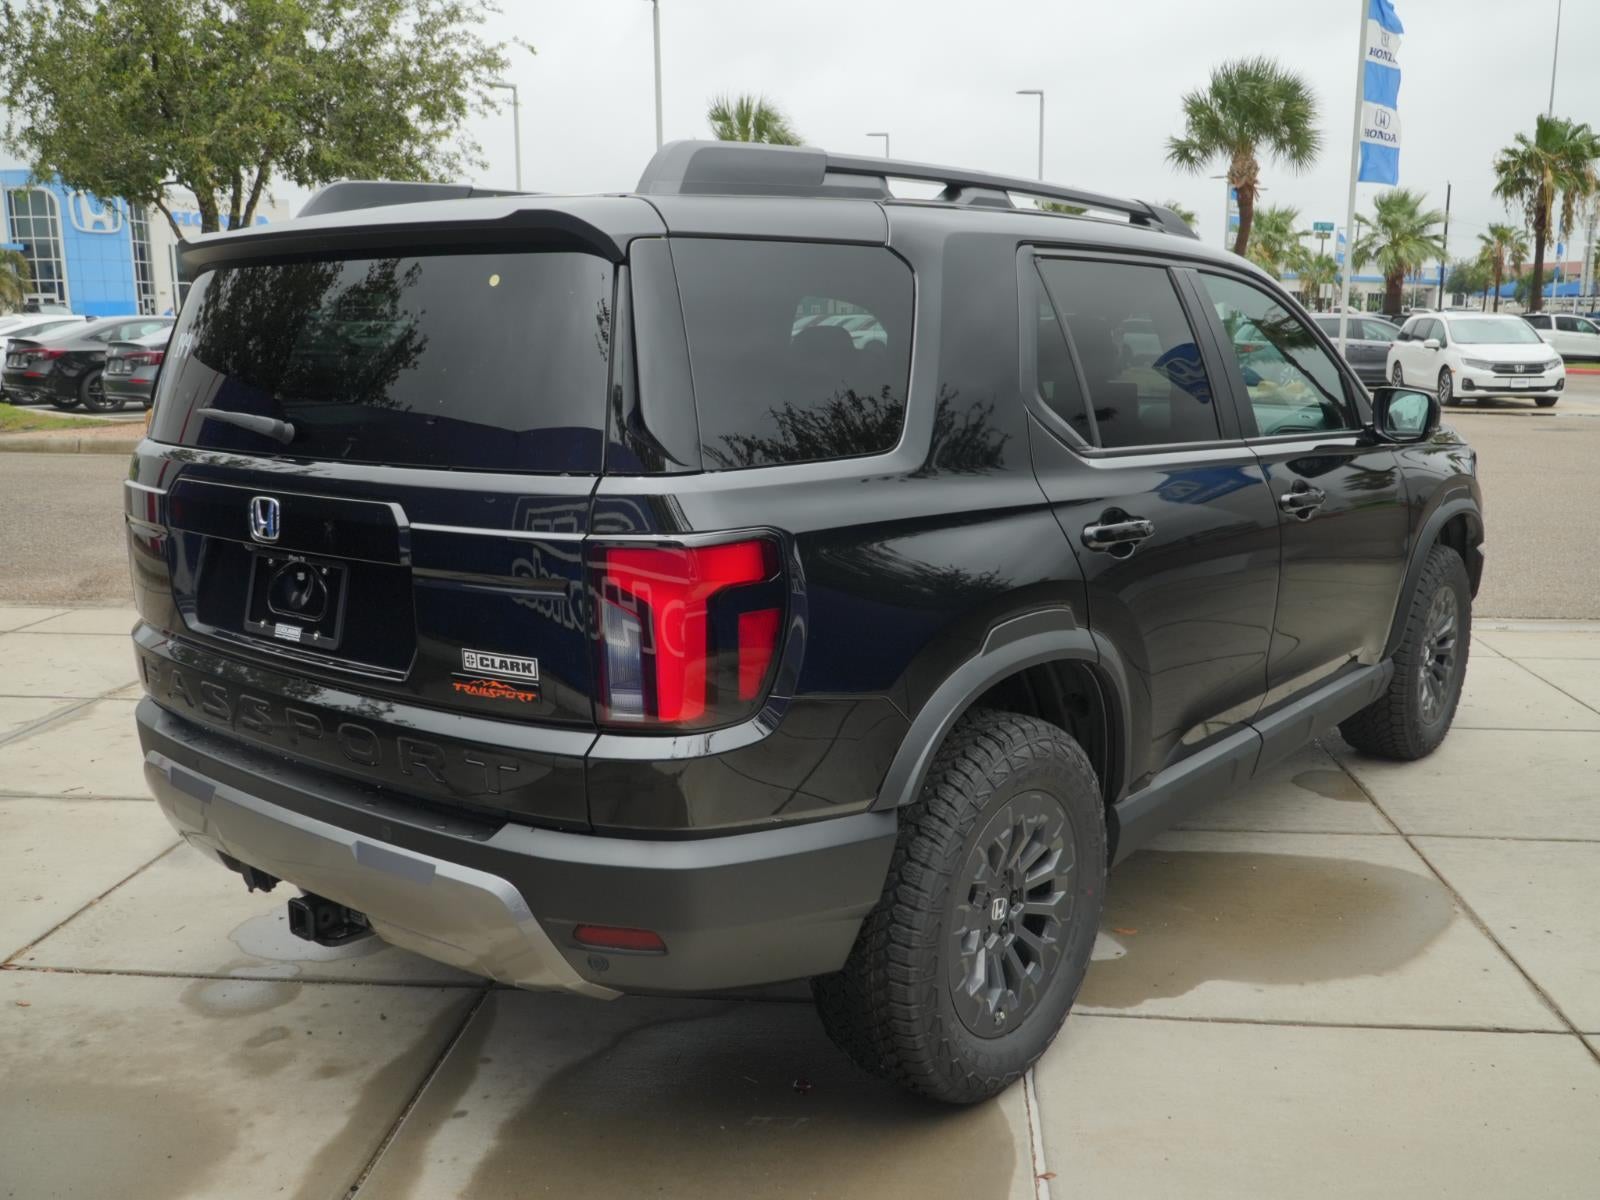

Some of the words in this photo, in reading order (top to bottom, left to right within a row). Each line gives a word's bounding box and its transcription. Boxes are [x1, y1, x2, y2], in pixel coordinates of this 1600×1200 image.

[1364, 128, 1397, 143] HONDA
[479, 656, 534, 674] CLARK
[452, 681, 537, 703] TRAILSPORT
[141, 655, 520, 797] PASSPORT
